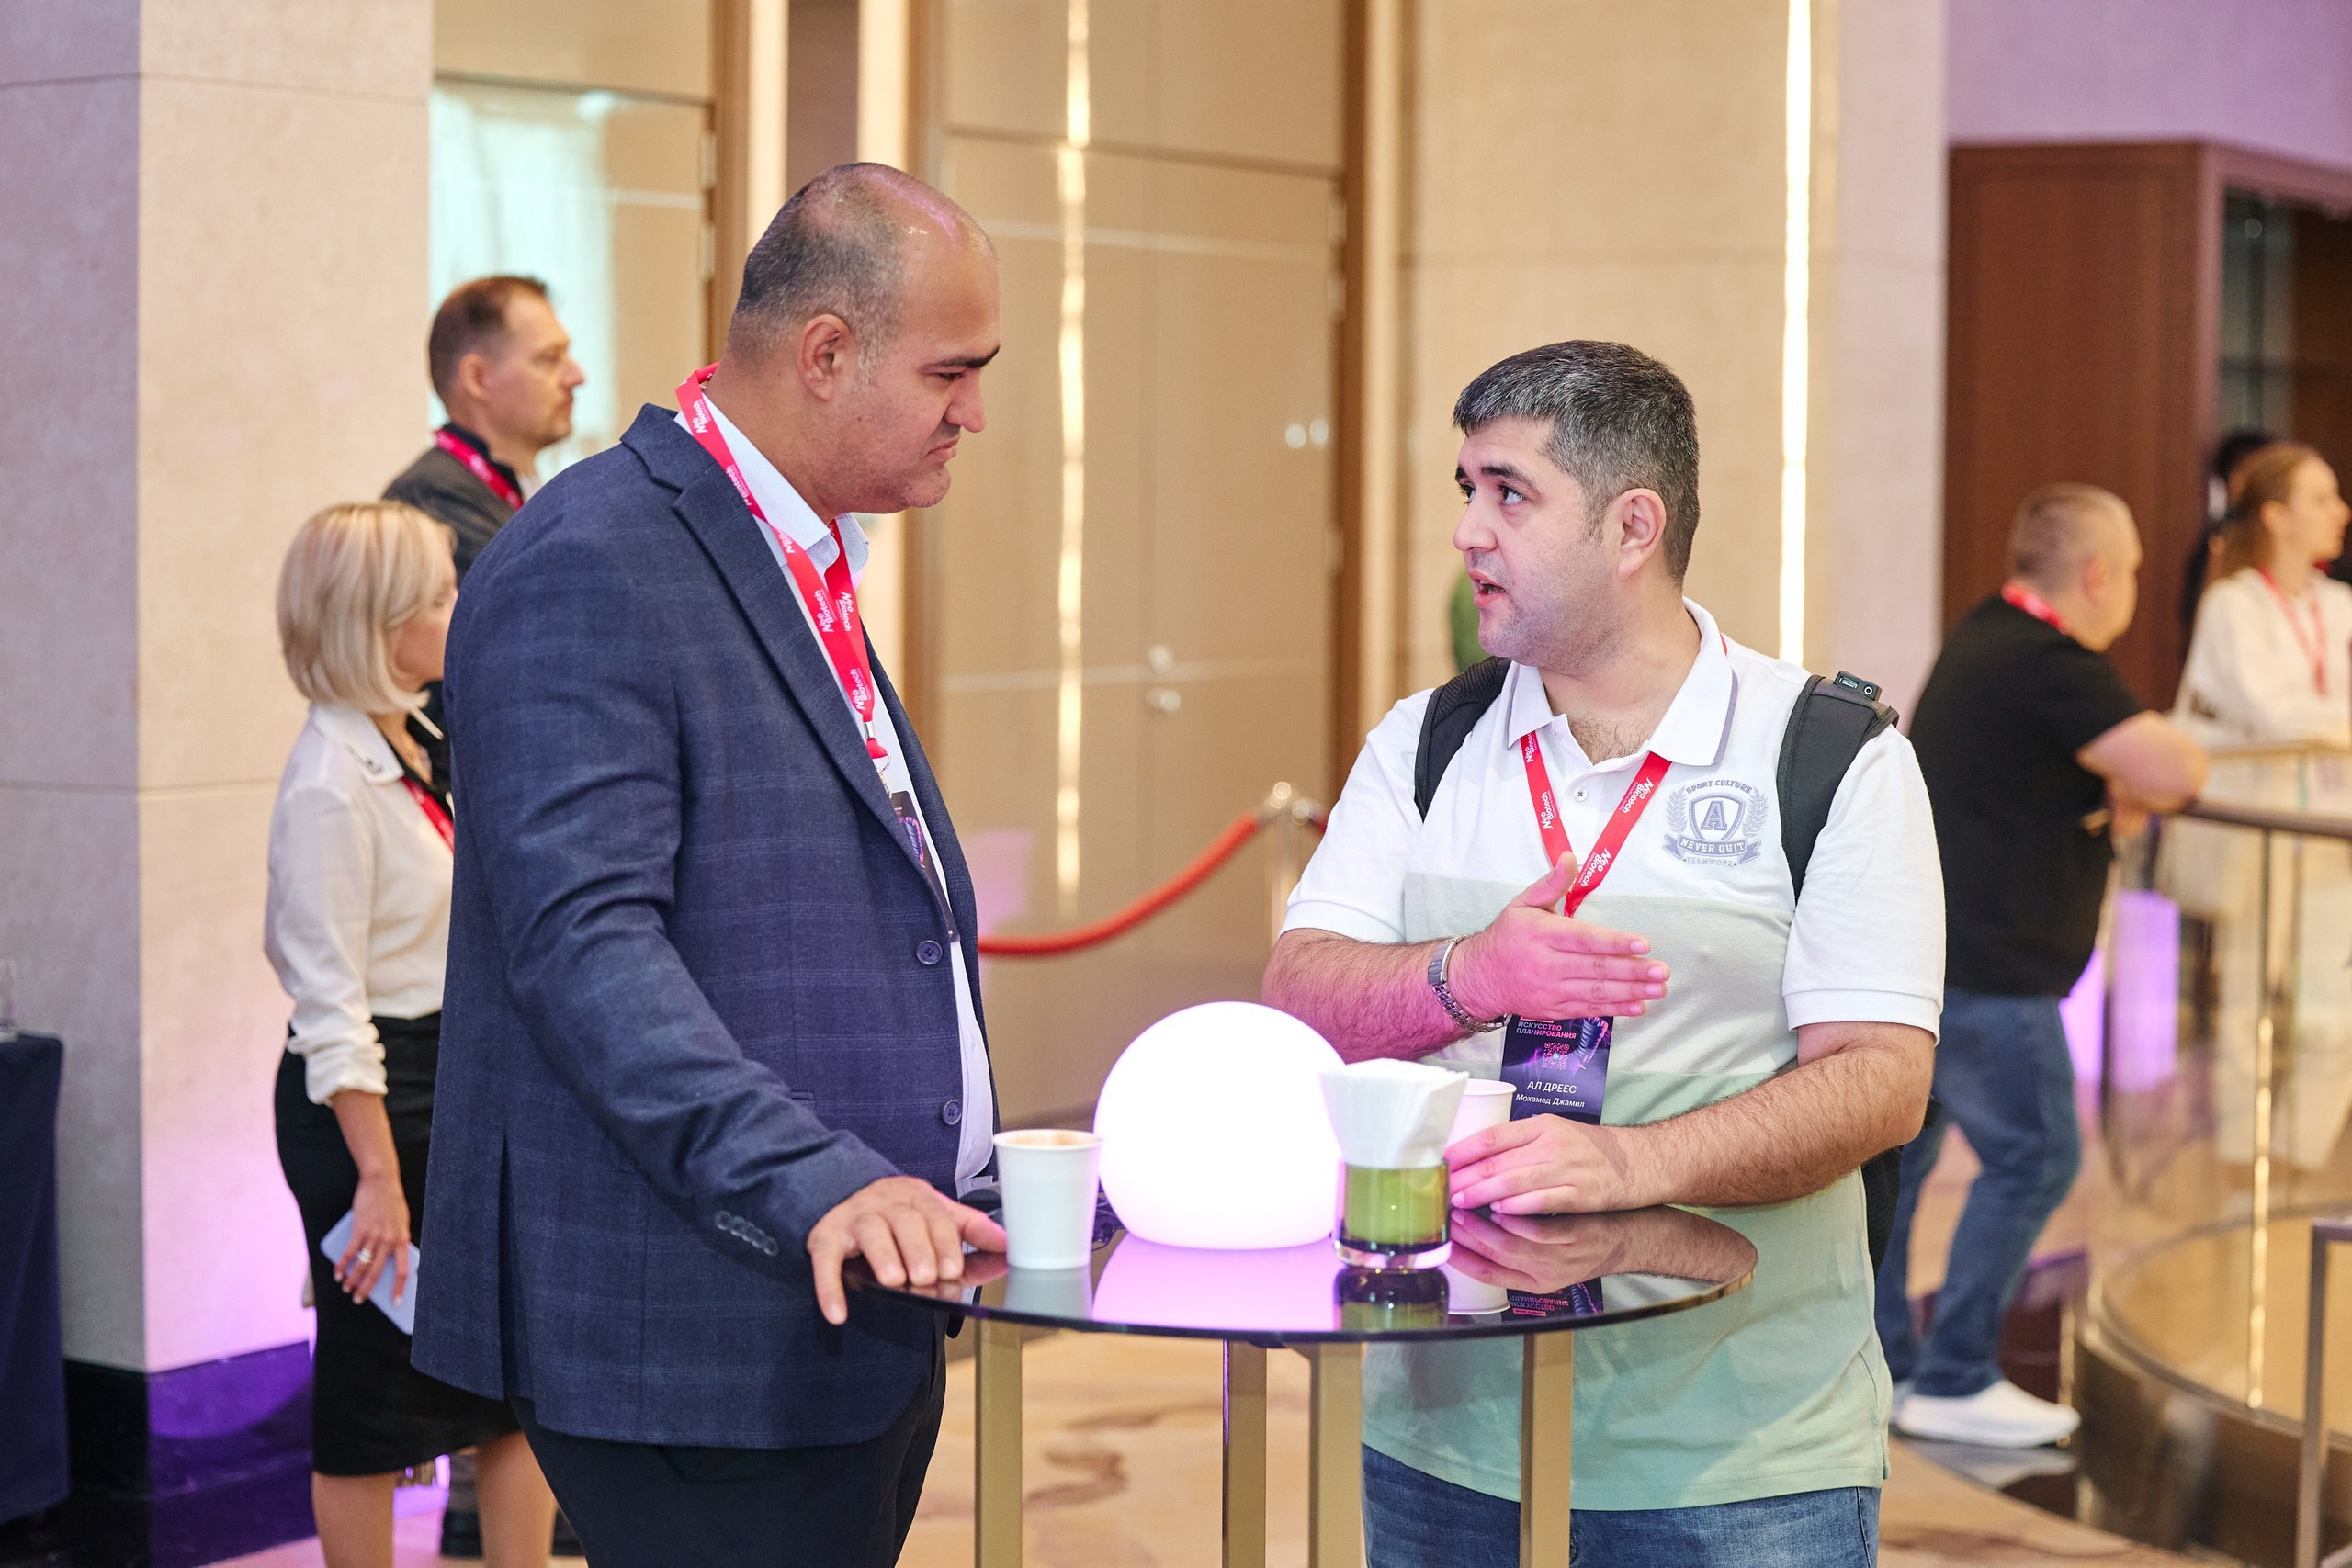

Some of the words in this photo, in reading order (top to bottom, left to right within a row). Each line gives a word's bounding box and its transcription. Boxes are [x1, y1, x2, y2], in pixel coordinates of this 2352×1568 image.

[814, 590, 833, 623] Biotech
[841, 592, 854, 613] Neo
[817, 613, 834, 633] Neo
[839, 599, 852, 631] Biotech
[850, 669, 867, 700] Biotech
[852, 690, 866, 711] Neo
[1639, 777, 1654, 800] Neo
[1686, 780, 1713, 795] SPORT
[1714, 779, 1753, 795] CULTURE
[1541, 791, 1555, 821] Biotech
[1623, 784, 1645, 814] Biotech
[1541, 812, 1554, 829] Neo
[1701, 800, 1728, 831] A
[1680, 838, 1715, 853] NEVER
[1718, 842, 1746, 854] QUIT
[1580, 853, 1603, 887] Biotech
[1598, 847, 1612, 872] Neo
[1516, 1028, 1577, 1039] ПЛАНИРОВАНИЯ
[1518, 1021, 1562, 1032] ИСКУССТВО
[1527, 1081, 1543, 1090] АЛ
[1543, 1082, 1577, 1094] ДРЕЕС
[1516, 1094, 1551, 1105] Мохамед
[1552, 1097, 1585, 1108] Джамил
